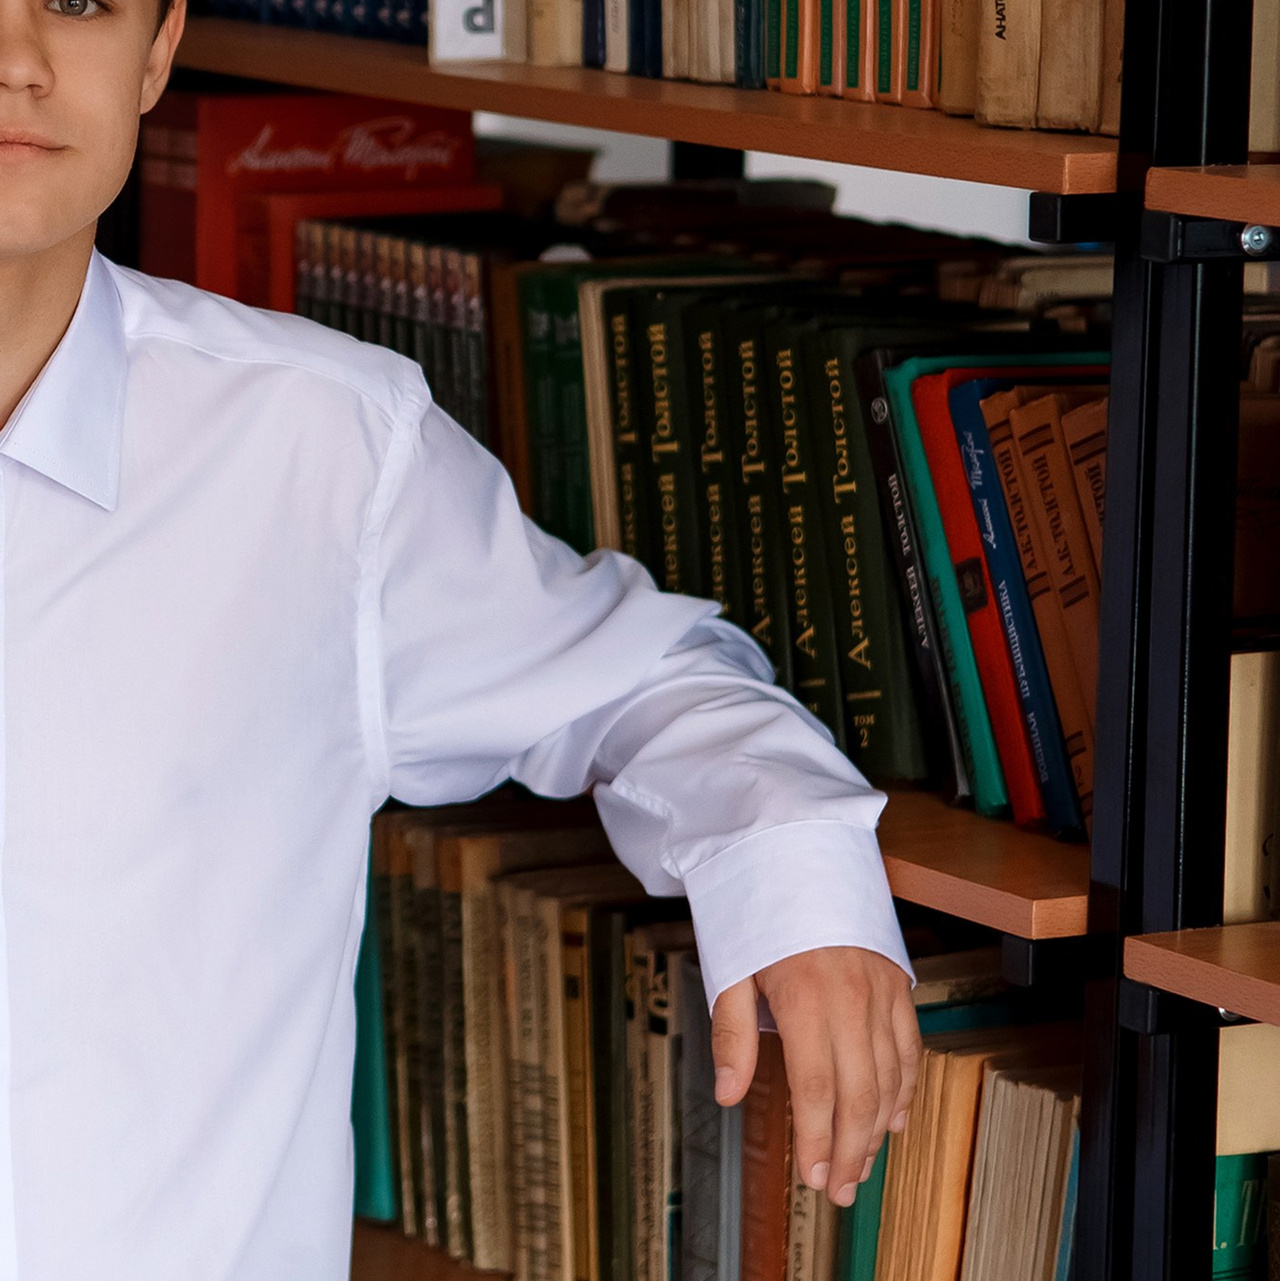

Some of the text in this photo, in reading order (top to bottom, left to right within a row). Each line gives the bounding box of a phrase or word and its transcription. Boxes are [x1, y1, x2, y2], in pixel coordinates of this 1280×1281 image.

[611, 314, 639, 555] ексей Толстой
[646, 323, 679, 591] лексей Толстой
[698, 330, 725, 602] лексей Толстой
[738, 340, 773, 648] Алексей Толстой
[777, 348, 816, 660] Алексей Толстой
[824, 357, 871, 671] Алексей Толстой
[888, 473, 929, 649] АЛЕКСЕЙ ТОЛСТОЙ
[1085, 463, 1104, 527] СТОЙ
[859, 728, 868, 747] 2
[998, 580, 1050, 782] ВОЕННАЯ ПУБЛИЦИСТИКА
